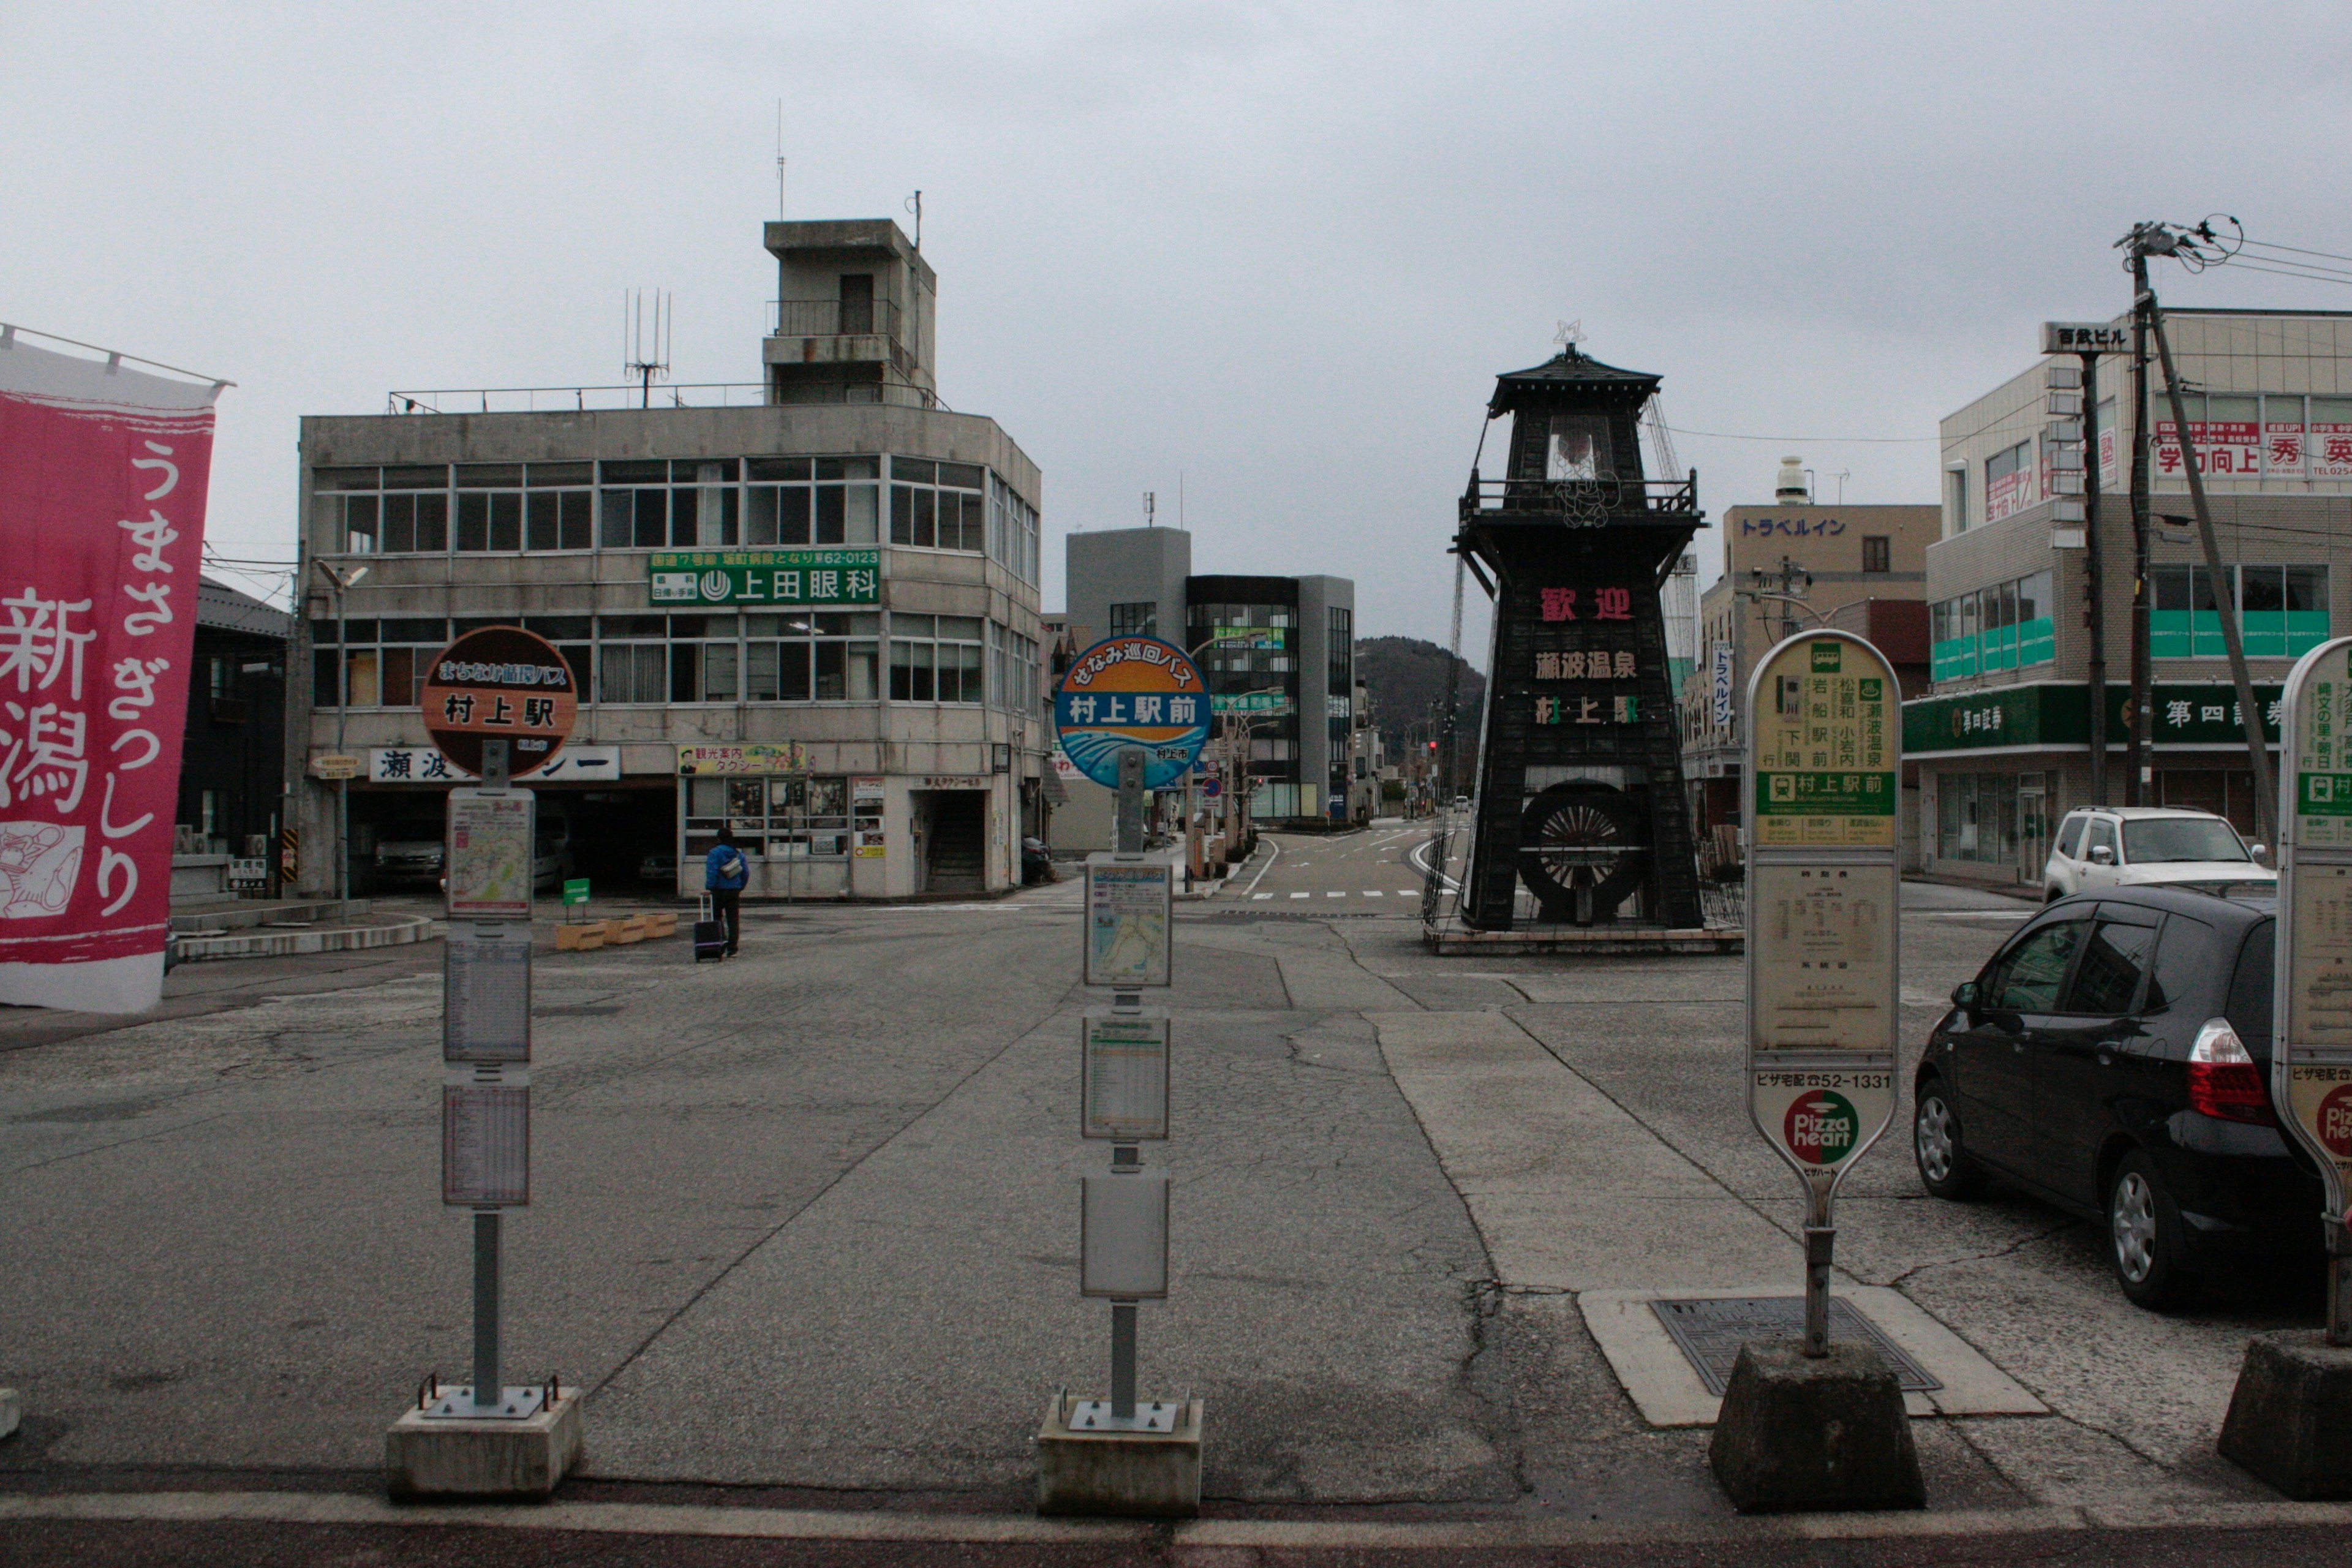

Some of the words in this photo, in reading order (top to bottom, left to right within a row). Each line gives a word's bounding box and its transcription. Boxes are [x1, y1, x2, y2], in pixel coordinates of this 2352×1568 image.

[2058, 328, 2127, 344] 百武ビル
[2313, 467, 2329, 475] TEL
[1743, 518, 1846, 536] トラベルイン
[736, 570, 876, 600] 上田眼科
[439, 660, 567, 685] まちなか循環バス
[1073, 642, 1193, 688] せなみ巡回バス
[1536, 651, 1638, 679] 瀬波温泉
[97, 440, 180, 917] うまさぎっしり
[1716, 651, 1728, 723] トラベルイン
[0, 587, 97, 814] 新潟
[445, 694, 555, 727] 村上駅
[1069, 696, 1196, 724] 村上駅前
[1536, 696, 1640, 724] 村上駅
[1812, 678, 1828, 767] 岩船駅前
[1963, 705, 2002, 735] 第四証券
[1839, 726, 1855, 767] 小岩内
[1866, 703, 1882, 767] 瀬波温泉
[696, 748, 742, 760] 観光案内
[1156, 748, 1189, 760] 村上市
[1763, 754, 1775, 766] 行
[1785, 730, 1800, 767] 下関
[716, 760, 761, 772] タクシー
[1798, 775, 1883, 793] 村上駅前
[1757, 1074, 1804, 1087] ピザ宅配
[1821, 1074, 1891, 1088] 52-1331
[2293, 1068, 2337, 1080] ピザ宅配
[1794, 1114, 1851, 1133] Pizza
[2325, 1124, 2352, 1139] he
[1793, 1131, 1850, 1147] heart
[1804, 1167, 1838, 1177] ピザハート
